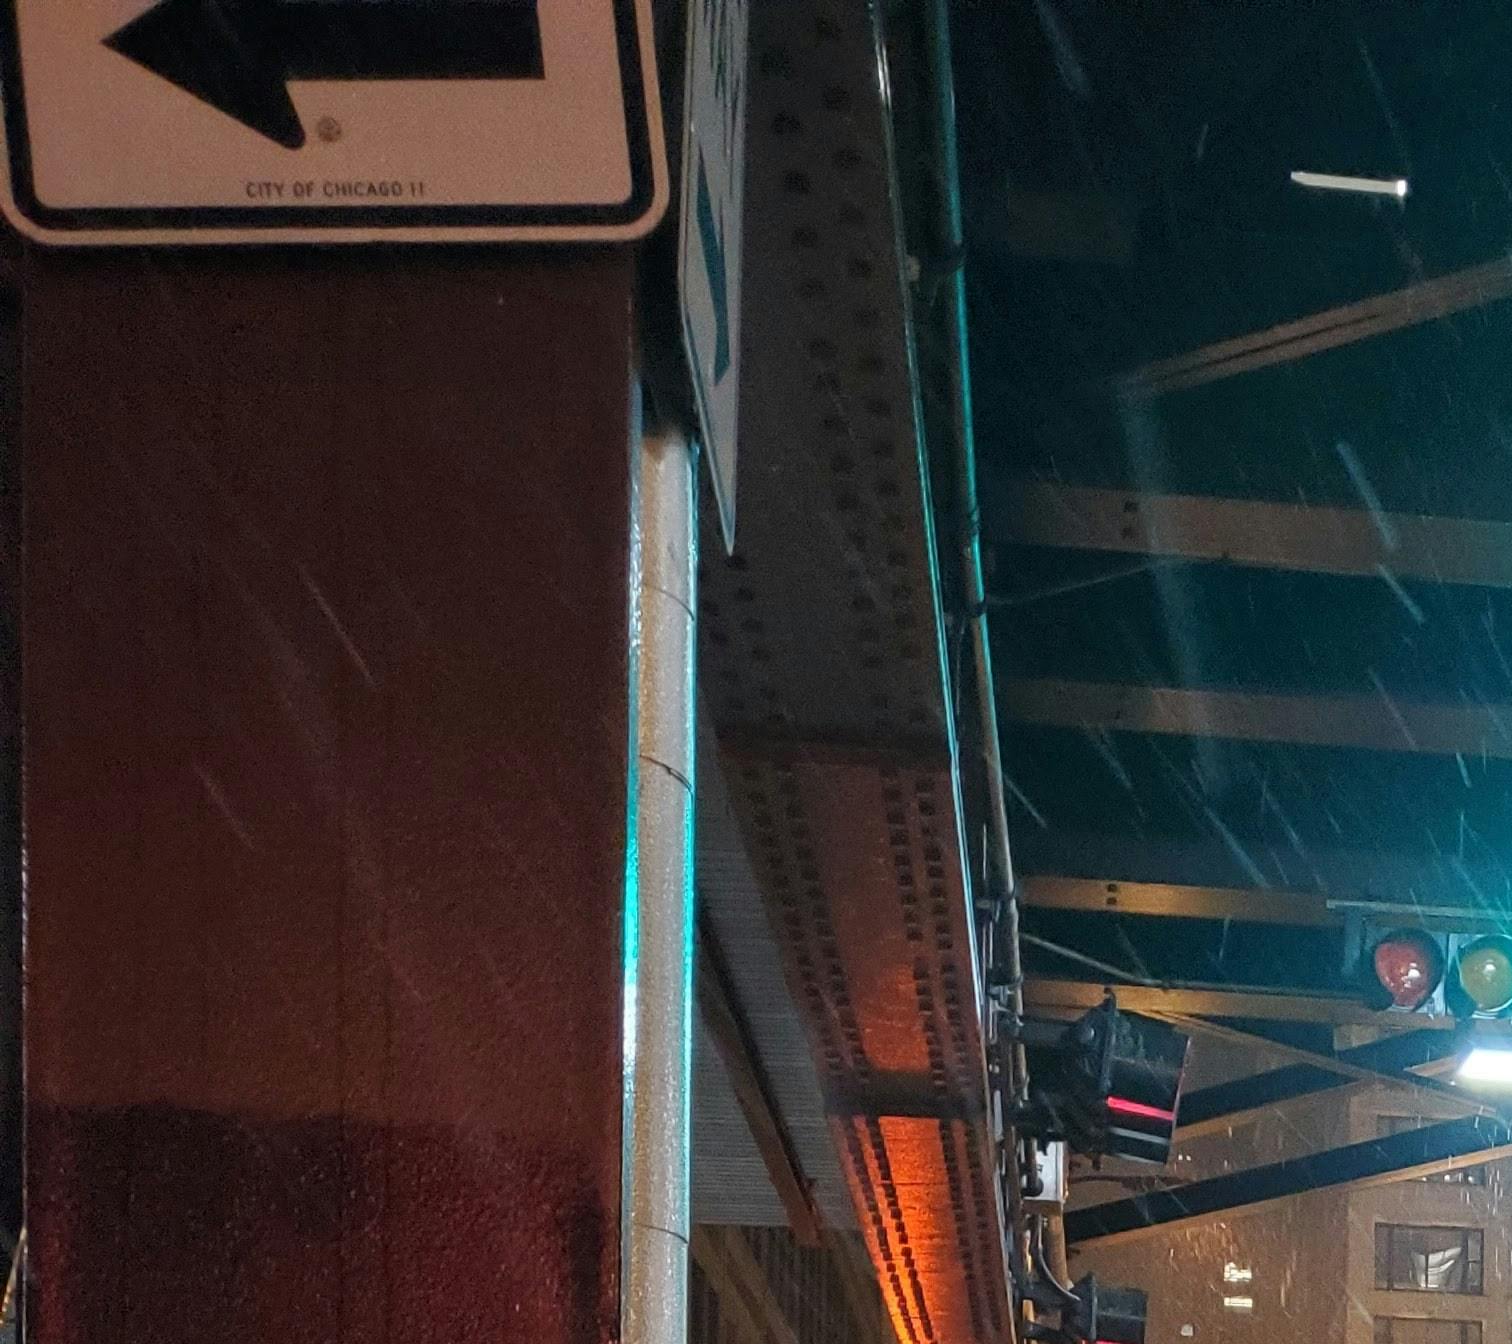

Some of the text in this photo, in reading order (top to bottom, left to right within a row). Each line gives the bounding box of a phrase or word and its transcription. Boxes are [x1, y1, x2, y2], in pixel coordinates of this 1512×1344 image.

[246, 181, 284, 198] CITY
[293, 181, 314, 197] OF
[323, 181, 403, 198] CHICAGO
